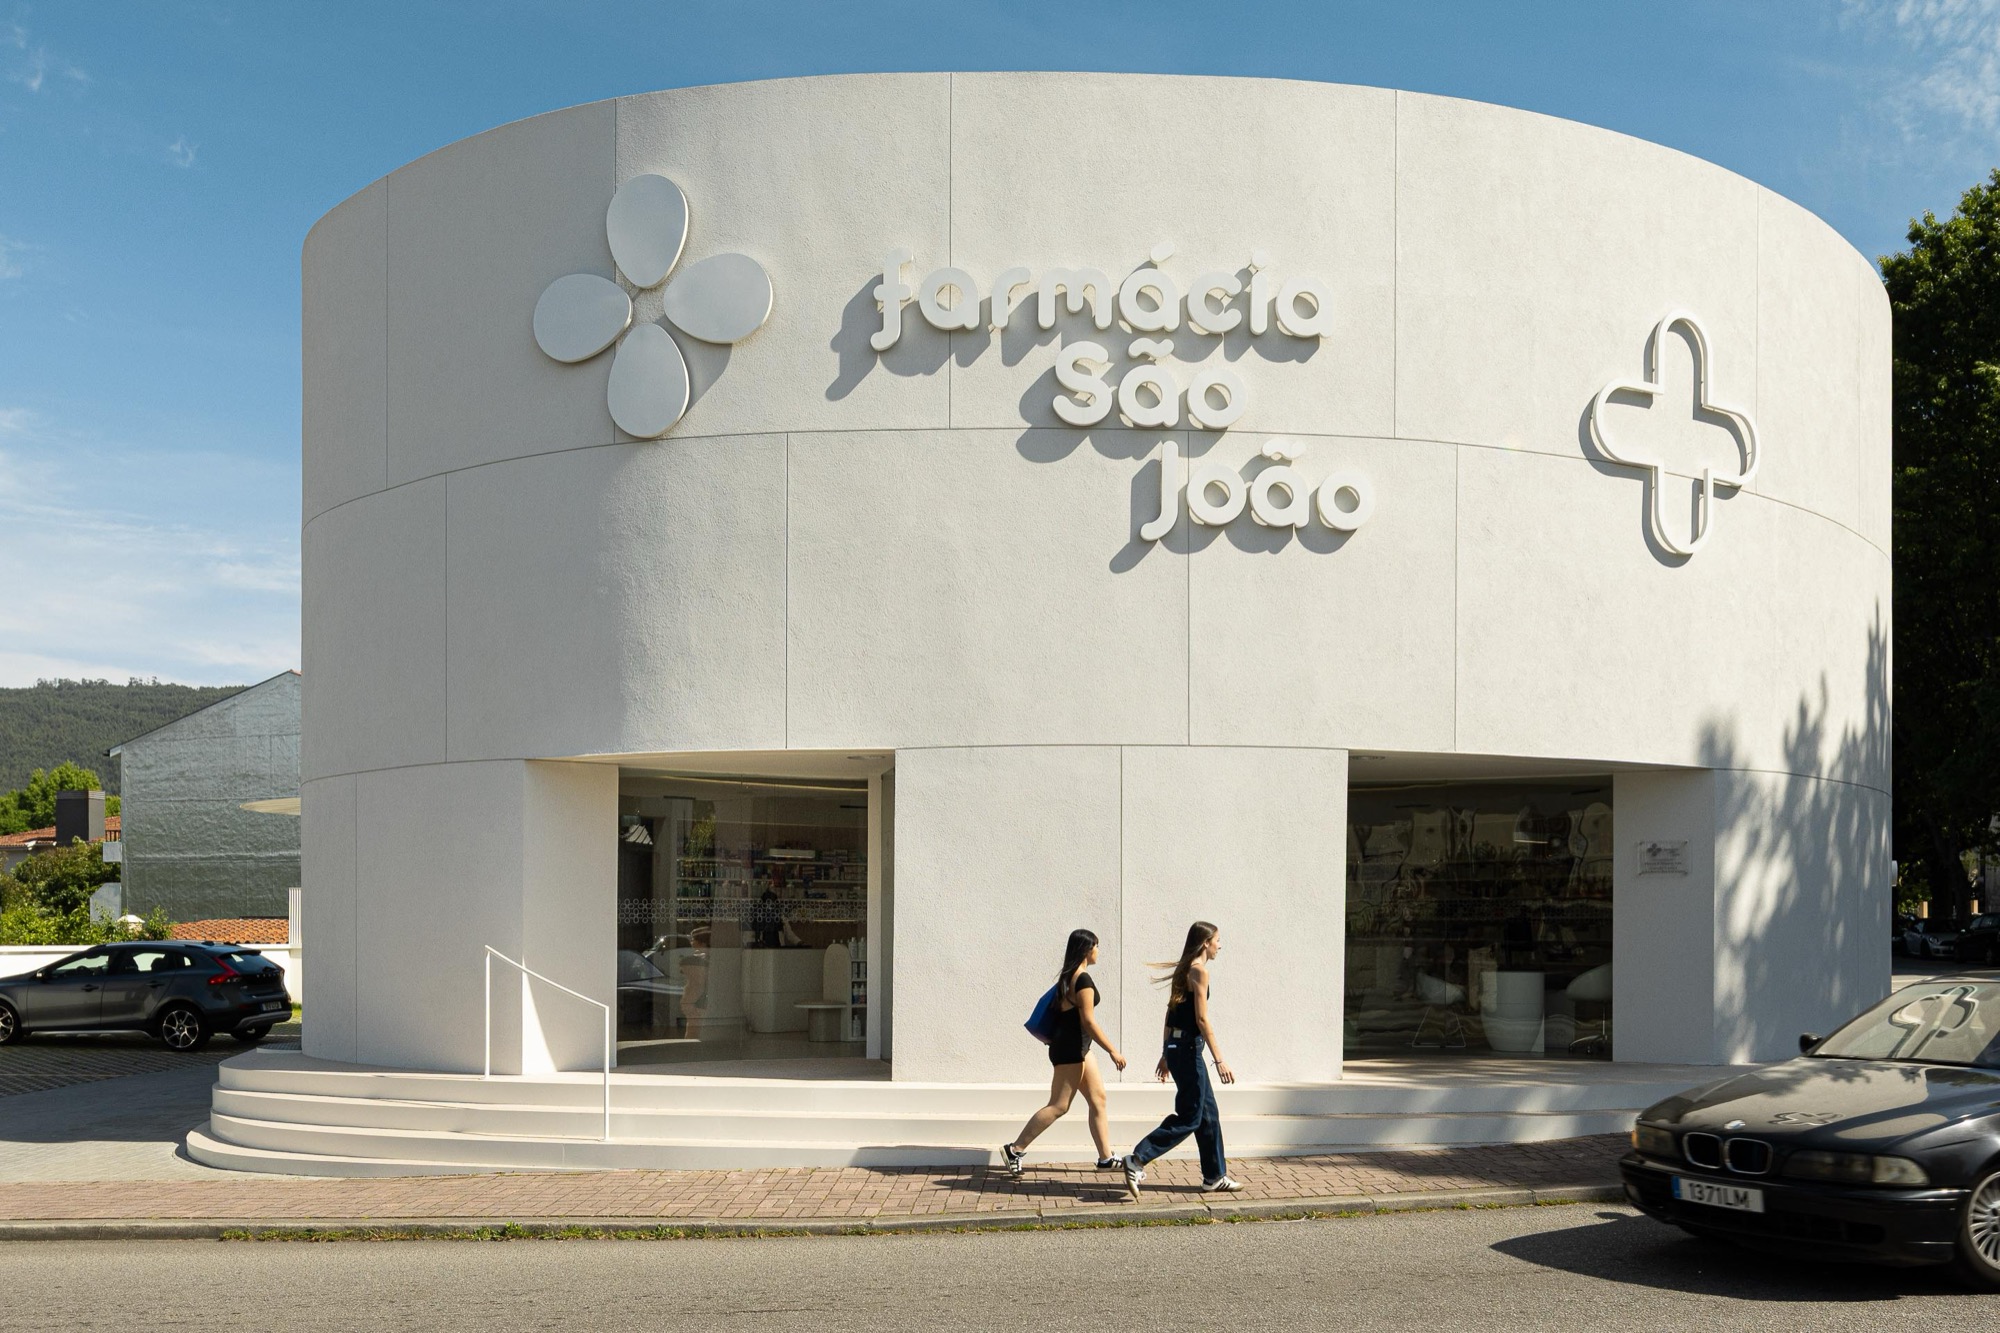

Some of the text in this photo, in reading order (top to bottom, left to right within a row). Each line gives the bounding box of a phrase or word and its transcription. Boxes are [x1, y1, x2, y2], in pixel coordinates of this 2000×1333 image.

[870, 241, 1333, 351] farmácia
[1052, 337, 1246, 429] São
[1140, 438, 1376, 541] João
